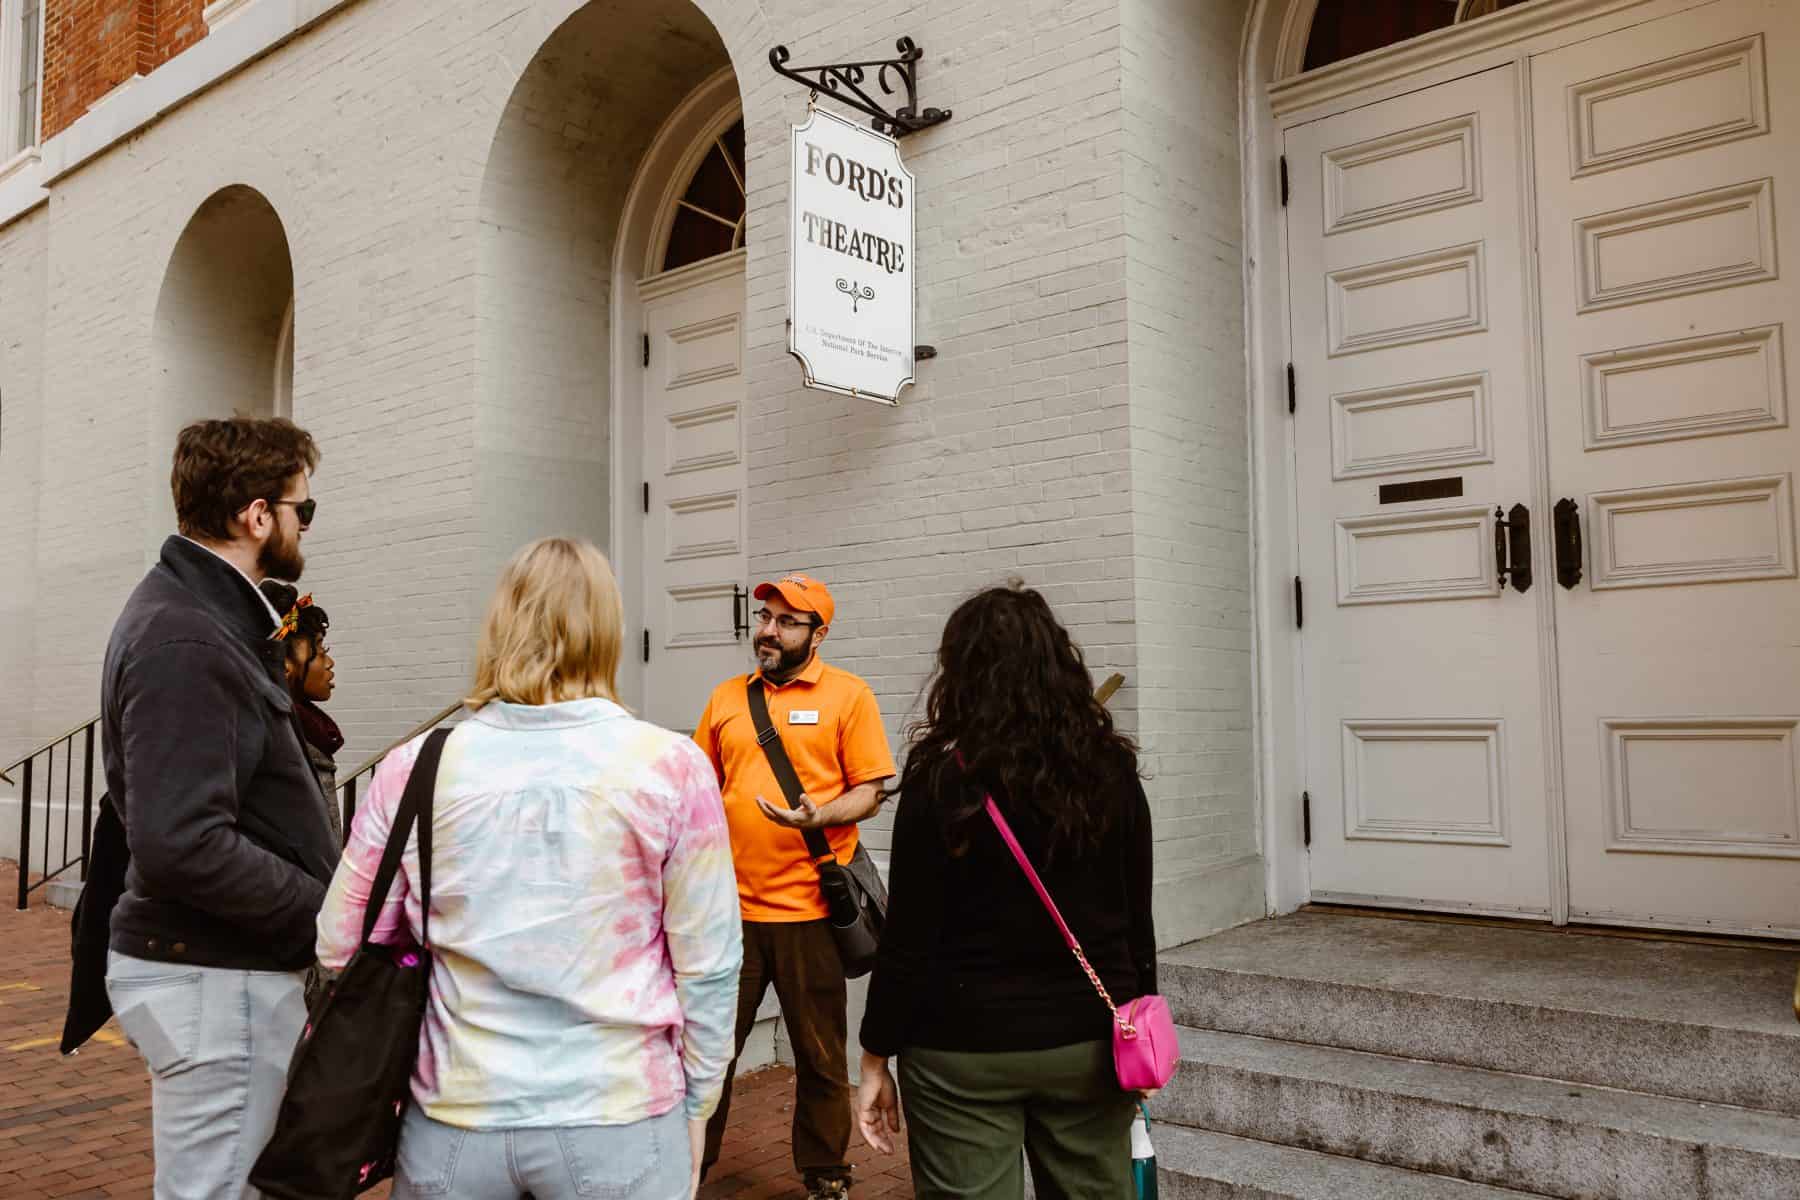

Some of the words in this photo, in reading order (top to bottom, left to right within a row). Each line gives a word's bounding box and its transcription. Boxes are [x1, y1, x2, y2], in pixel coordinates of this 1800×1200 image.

[804, 141, 904, 209] FORD'S
[802, 210, 905, 274] THEATRE
[849, 344, 864, 357] Park
